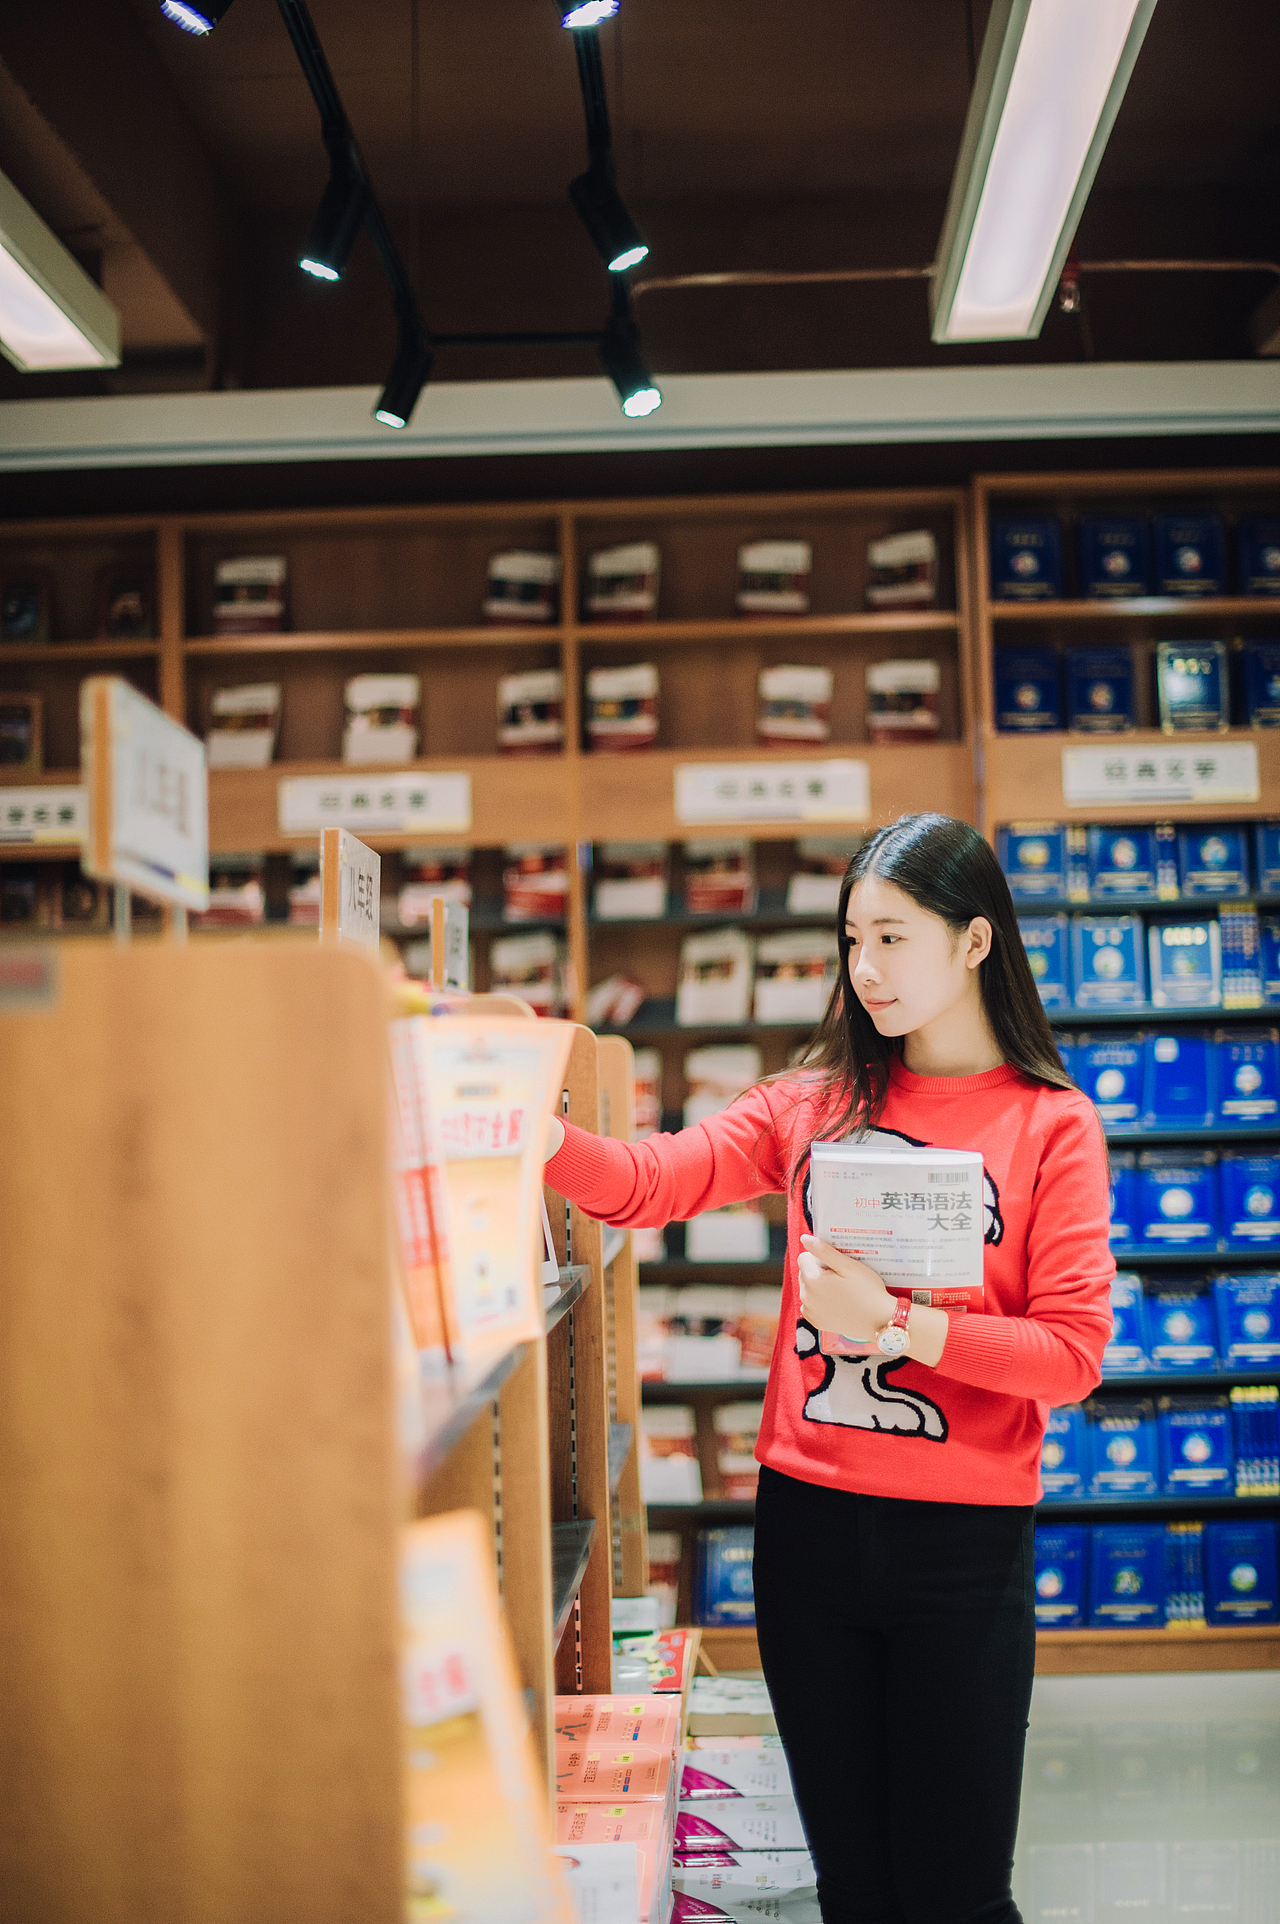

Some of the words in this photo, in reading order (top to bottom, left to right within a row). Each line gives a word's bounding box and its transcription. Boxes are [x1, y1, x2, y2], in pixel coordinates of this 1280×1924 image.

[348, 866, 374, 921] 八年级
[854, 1191, 973, 1211] 初中英语语法
[927, 1212, 973, 1231] 大全
